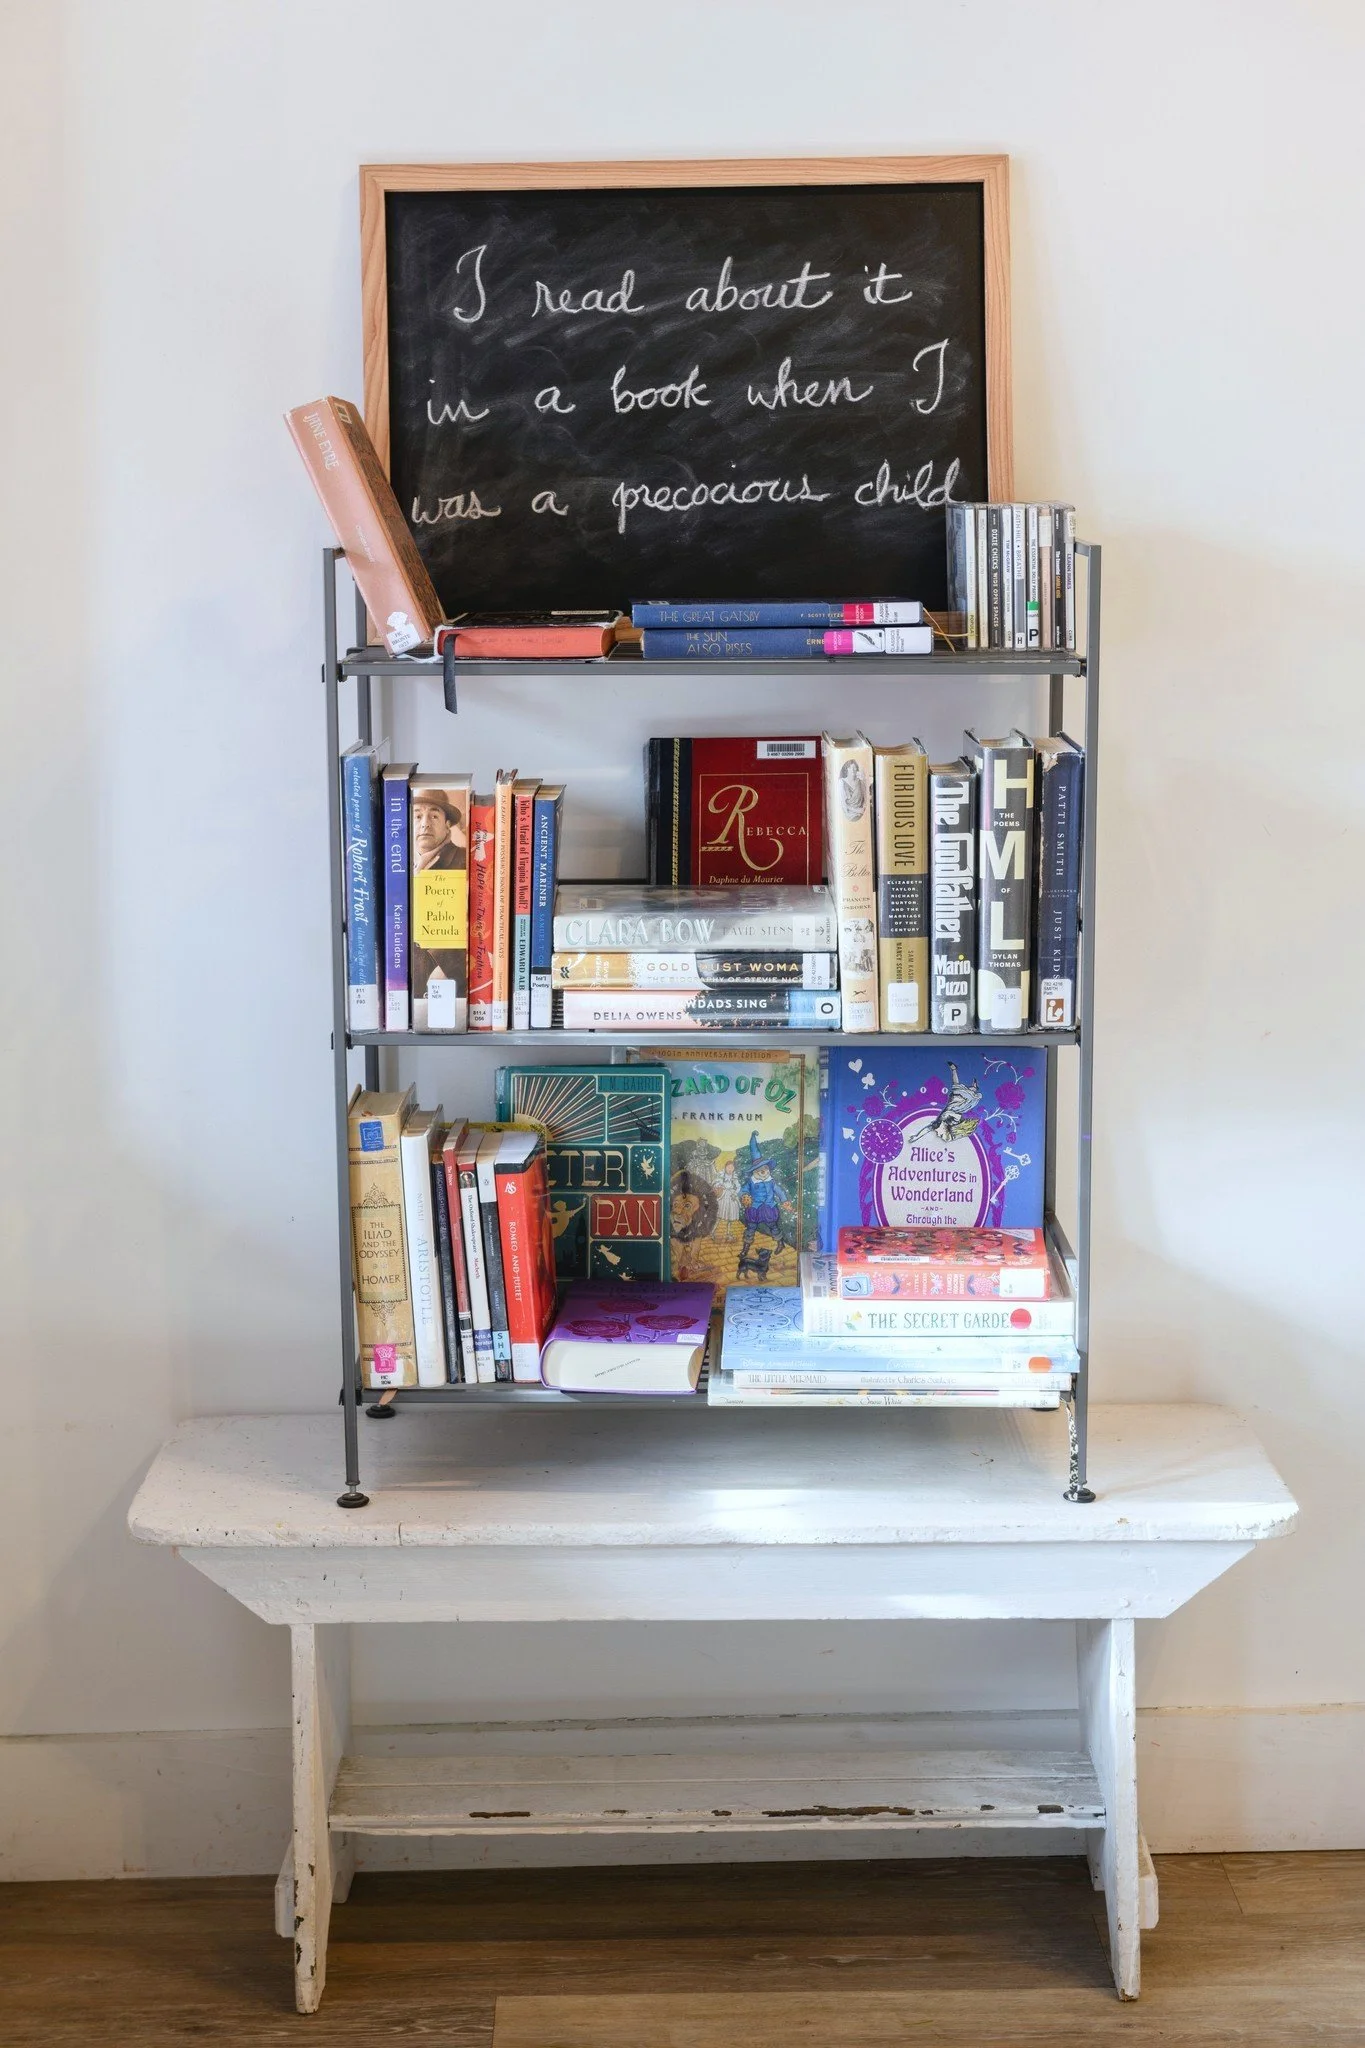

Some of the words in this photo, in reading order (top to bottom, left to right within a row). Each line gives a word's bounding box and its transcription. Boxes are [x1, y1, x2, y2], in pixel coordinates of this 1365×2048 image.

[455, 245, 486, 322] I
[532, 270, 644, 317] read
[685, 257, 834, 311] about
[864, 263, 913, 304] it
[427, 379, 490, 425] in
[535, 379, 576, 414] a
[611, 364, 711, 414] book
[748, 357, 874, 407] when
[910, 338, 949, 414] I
[303, 413, 327, 439] JANE
[319, 440, 339, 471] EYRE
[412, 490, 501, 525] was
[532, 491, 569, 515] a
[612, 461, 828, 534] precocious
[854, 457, 970, 510] child
[660, 611, 679, 623] THE
[682, 611, 715, 623] GREAT
[720, 611, 761, 623] GATSBY
[685, 632, 700, 641] THE
[704, 631, 728, 642] SUN
[1030, 629, 1039, 641] P
[686, 643, 721, 655] ALSO
[726, 643, 753, 655] RISES
[354, 767, 362, 798] selected
[391, 798, 405, 812] in
[894, 764, 915, 828] FURIOUS
[936, 781, 970, 825] The
[1058, 786, 1067, 825] PATTI
[351, 798, 361, 822] poems
[520, 800, 530, 822] Who's
[353, 823, 363, 833] of
[391, 818, 403, 839] the
[520, 826, 530, 847] Afraid
[708, 784, 806, 871] REBECCA
[520, 847, 529, 858] of
[845, 840, 865, 855] The
[894, 834, 915, 867] LOVE
[1056, 833, 1065, 876] SMITH
[346, 836, 368, 886] Robert
[391, 844, 406, 873] end
[434, 874, 447, 883] The
[518, 858, 529, 883] Virginia
[709, 876, 739, 885] Daphne
[424, 884, 457, 899] Poetry
[539, 862, 547, 907] MARINER
[935, 832, 975, 943] Godfather
[352, 888, 369, 926] Frost
[436, 900, 445, 908] of
[518, 884, 529, 910] Woolf?
[394, 904, 403, 930] Karie
[426, 910, 455, 922] Pablo
[1053, 911, 1062, 941] JUST
[422, 924, 460, 937] Neruda
[566, 918, 649, 946] CLARA
[659, 918, 715, 945] BOW
[722, 926, 756, 936] DAVID
[762, 926, 793, 936] STENN
[394, 932, 404, 969] Luidens
[518, 940, 526, 973] EDWARD
[647, 963, 690, 972] GOLD
[750, 963, 799, 972] WOMA
[934, 954, 971, 976] Mario
[1053, 949, 1061, 980] KIDS
[936, 976, 968, 996] Puzo
[736, 1000, 767, 1009] SING
[952, 1009, 961, 1021] P
[594, 1012, 631, 1020] DELIA
[636, 1012, 682, 1020] OWENS
[686, 1051, 738, 1059] ANNIVERSARY
[624, 1076, 661, 1091] BARRIE
[671, 1074, 730, 1098] ZARD
[735, 1075, 764, 1096] OF
[682, 1112, 724, 1121] FRANK
[729, 1112, 763, 1122] BAUM
[910, 1147, 956, 1163] Alice's
[888, 1166, 966, 1183] Adventures
[969, 1174, 977, 1183] in
[891, 1186, 974, 1203] Wonderland
[595, 1200, 660, 1236] PAN
[906, 1214, 943, 1226] Through
[944, 1216, 957, 1225] the
[364, 1230, 393, 1240] ILIAD
[470, 1222, 478, 1253] Shakespeare
[509, 1222, 518, 1252] ROMEO
[359, 1249, 399, 1259] ODYSSEY
[512, 1254, 520, 1275] AND
[362, 1275, 401, 1285] HOMER
[418, 1235, 433, 1325] ARISTOTLE
[514, 1276, 522, 1302] JULIET
[868, 1312, 897, 1329] THE
[904, 1312, 960, 1329] SECRET
[964, 1312, 1009, 1329] GARDE
[764, 1374, 787, 1384] LITTLE
[789, 1374, 827, 1384] MERMAID
[897, 1376, 926, 1385] Charles
